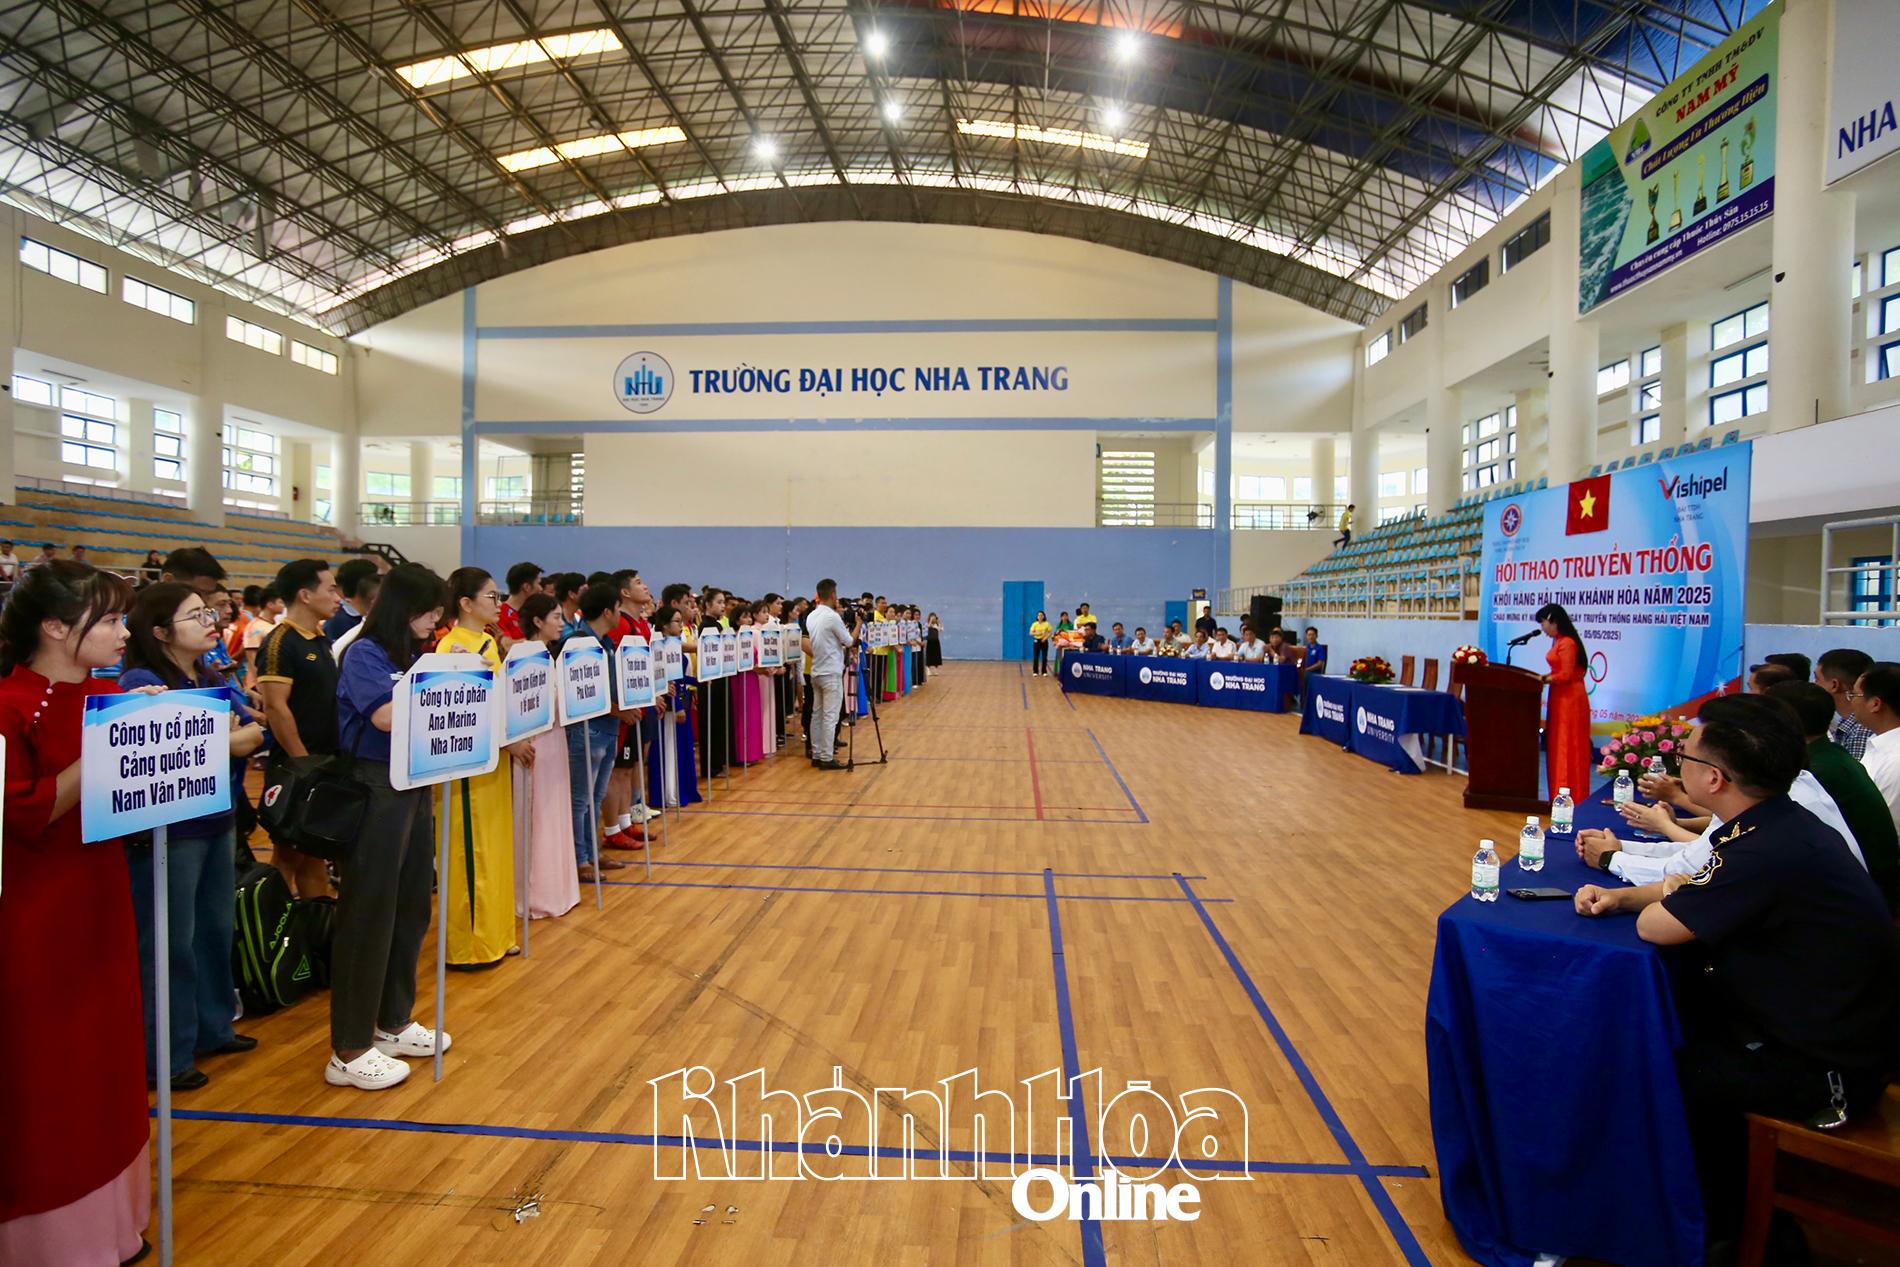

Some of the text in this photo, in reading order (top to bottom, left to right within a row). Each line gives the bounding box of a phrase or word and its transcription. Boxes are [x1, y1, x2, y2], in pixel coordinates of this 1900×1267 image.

[1696, 61, 1722, 87] TNHH
[1676, 62, 1739, 123] NAM MỸ
[1838, 100, 1898, 159] NHA
[689, 362, 1069, 397] TRƯỜNG ĐẠI HỌC NHA TRANG
[1658, 465, 1728, 500] Vishipel
[1520, 559, 1559, 581] THAO
[1636, 536, 1712, 574] THỐNG
[1617, 585, 1640, 605] HÒA
[1644, 585, 1673, 604] NĂM
[1677, 587, 1711, 604] 2025
[1689, 614, 1709, 625] NAM
[1095, 665, 1112, 674] TRANG
[1152, 676, 1187, 686] NHA TRANG
[420, 683, 487, 708] Công ty cổ phần
[1225, 682, 1265, 691] NHA TRANG
[110, 710, 214, 747] Công ty cổ phần
[428, 710, 476, 731] Ana Marina
[1367, 711, 1394, 731] NHA TRANG
[431, 735, 473, 756] Nha Trang
[120, 740, 207, 779] Cảng quốc tế
[112, 775, 216, 814] Nam Vân Phong
